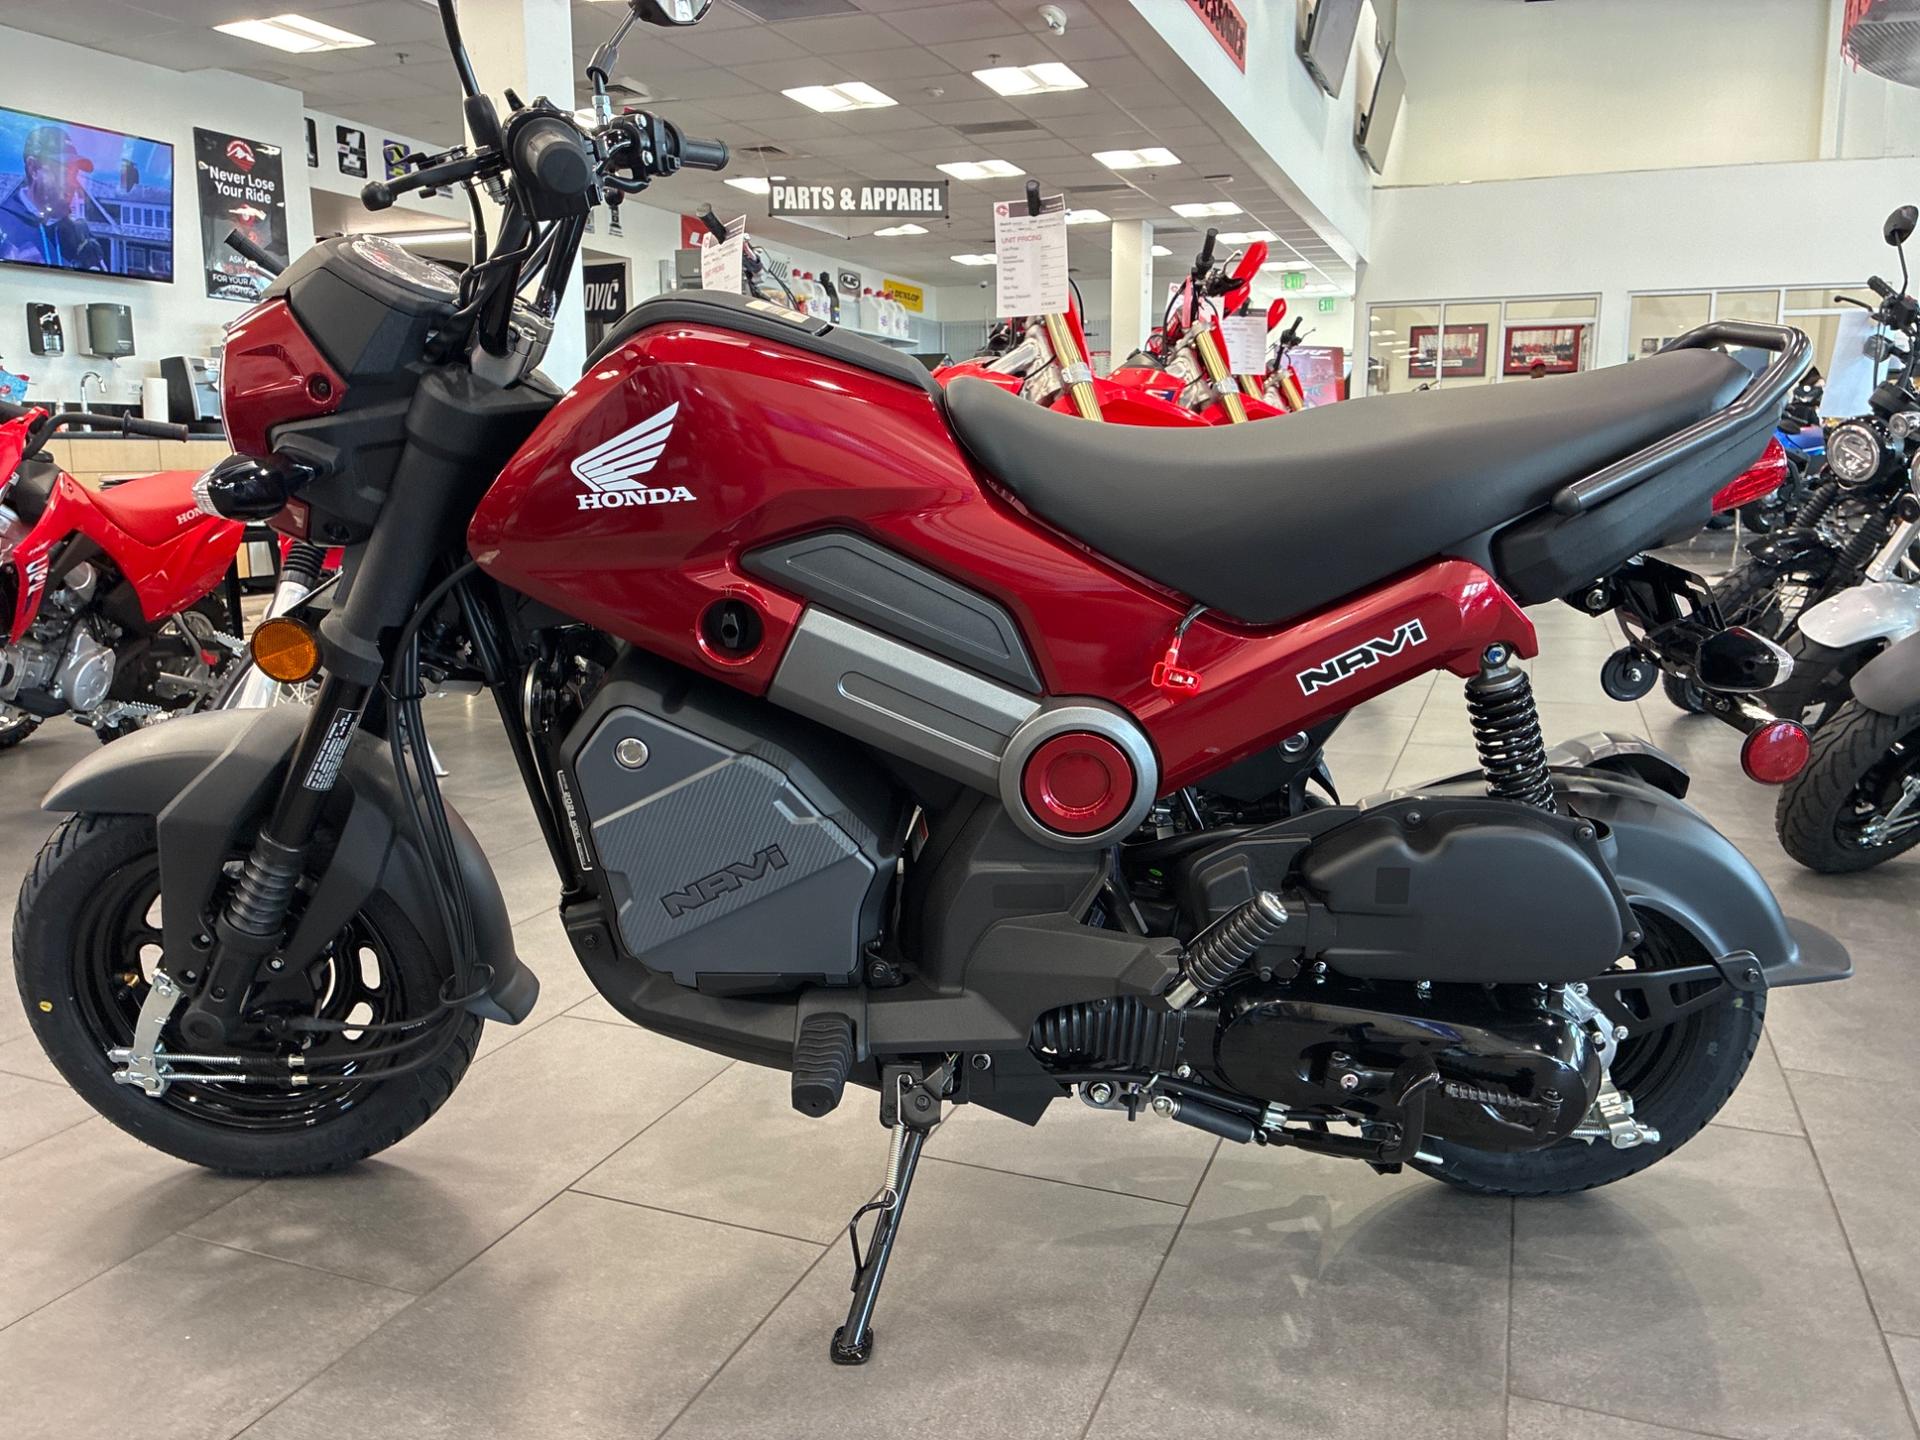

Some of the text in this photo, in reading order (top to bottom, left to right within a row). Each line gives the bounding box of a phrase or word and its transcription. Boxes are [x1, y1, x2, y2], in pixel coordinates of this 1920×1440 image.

[209, 165, 275, 192] Never Lose
[214, 181, 272, 204] Your Ride
[772, 186, 943, 211] PARTS & APPAREL
[229, 255, 243, 264] ASK
[212, 273, 228, 283] FOR
[228, 276, 249, 286] YOUR
[894, 290, 920, 302] DUNLOP
[575, 486, 697, 510] HONDA
[563, 791, 577, 818] 2026
